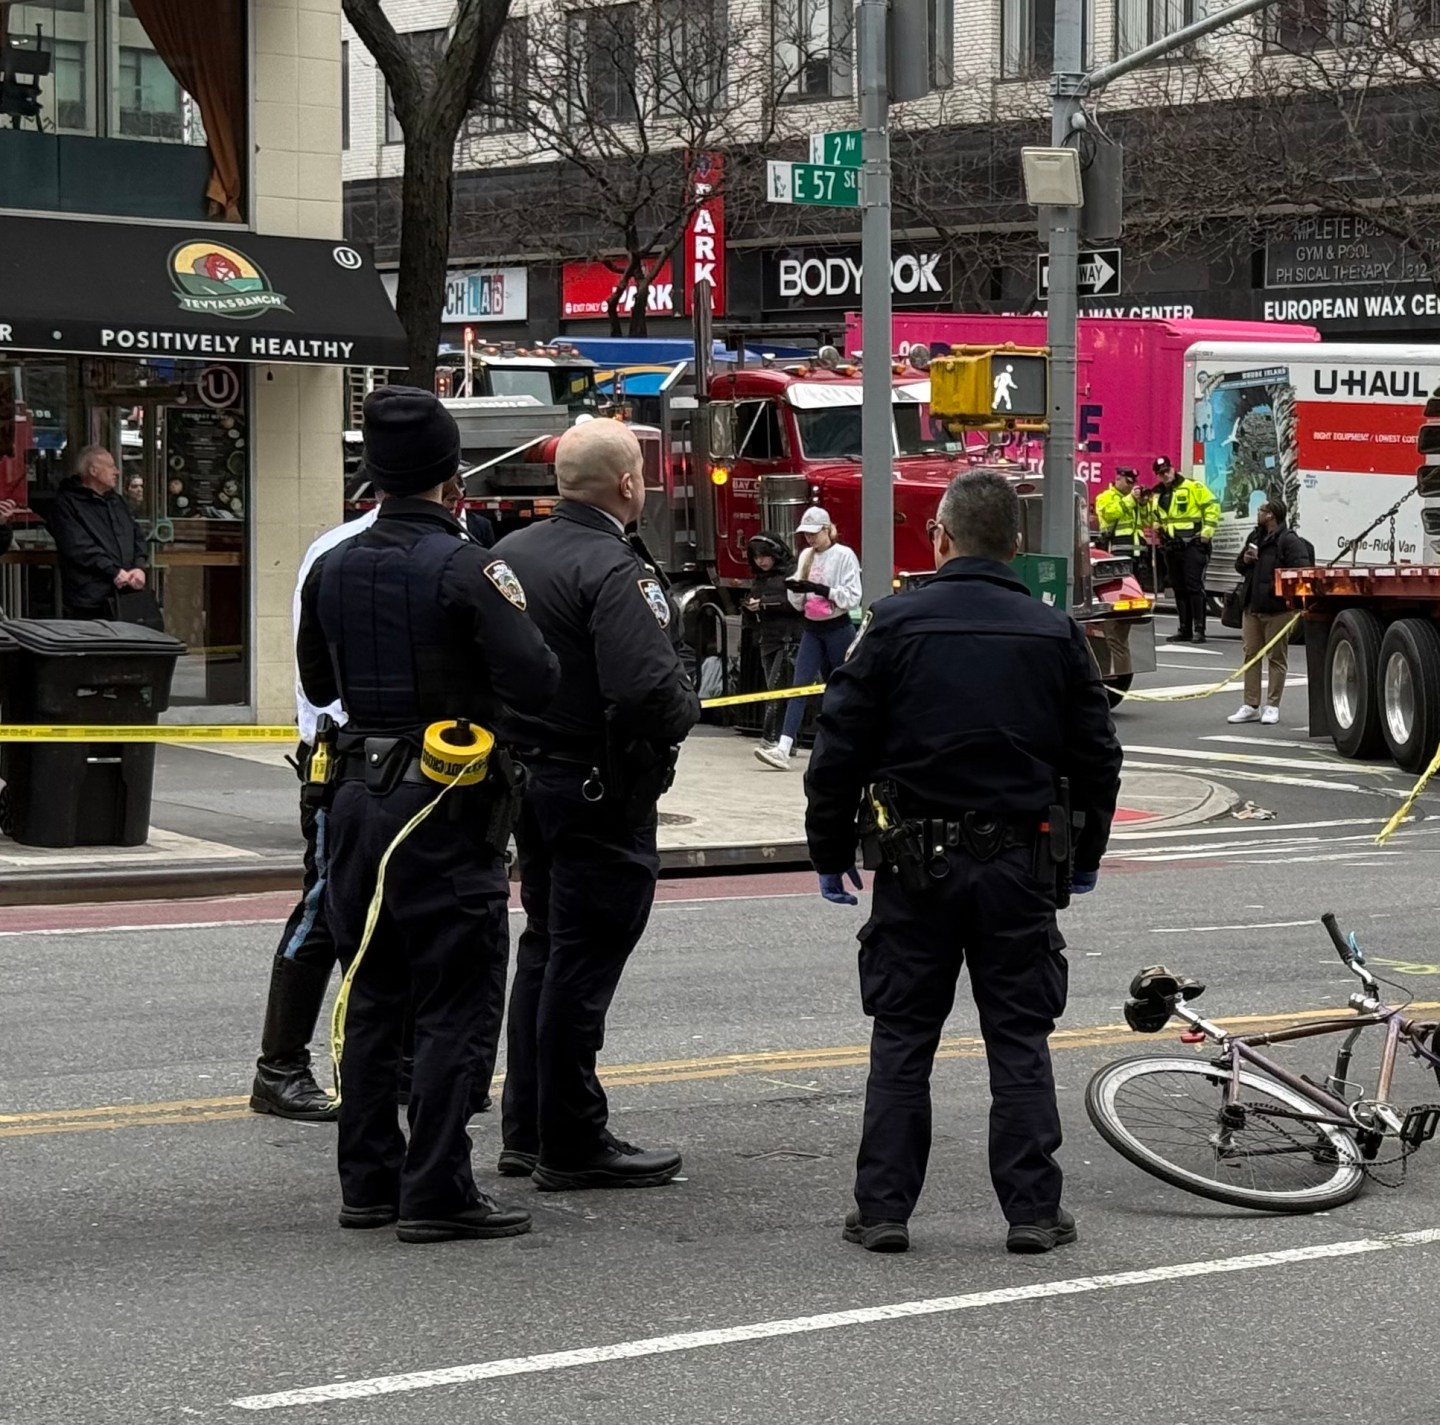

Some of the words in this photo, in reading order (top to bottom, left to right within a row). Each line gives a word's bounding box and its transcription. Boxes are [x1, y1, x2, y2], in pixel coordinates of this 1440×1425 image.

[834, 139, 842, 165] 2
[845, 134, 855, 152] Av
[795, 169, 804, 197] E
[813, 171, 836, 200] 57
[843, 171, 855, 189] St
[1296, 246, 1323, 261] GYM
[1326, 245, 1334, 260] &
[1338, 244, 1371, 259] POOL
[780, 254, 943, 296] BODYOK
[1078, 265, 1103, 283] WAY
[1333, 263, 1391, 279] THERAPY
[235, 295, 281, 307] RANCH
[611, 284, 673, 312] ARK
[1129, 305, 1194, 319] CENTER
[1264, 297, 1358, 321] EUROPEAN
[1364, 295, 1406, 317] WAX
[101, 329, 241, 353] POSITIVELY
[251, 337, 354, 360] HEALTHY
[1313, 431, 1332, 440] RIGHT
[1375, 434, 1401, 443] LOWEST
[1398, 540, 1416, 553] Van
